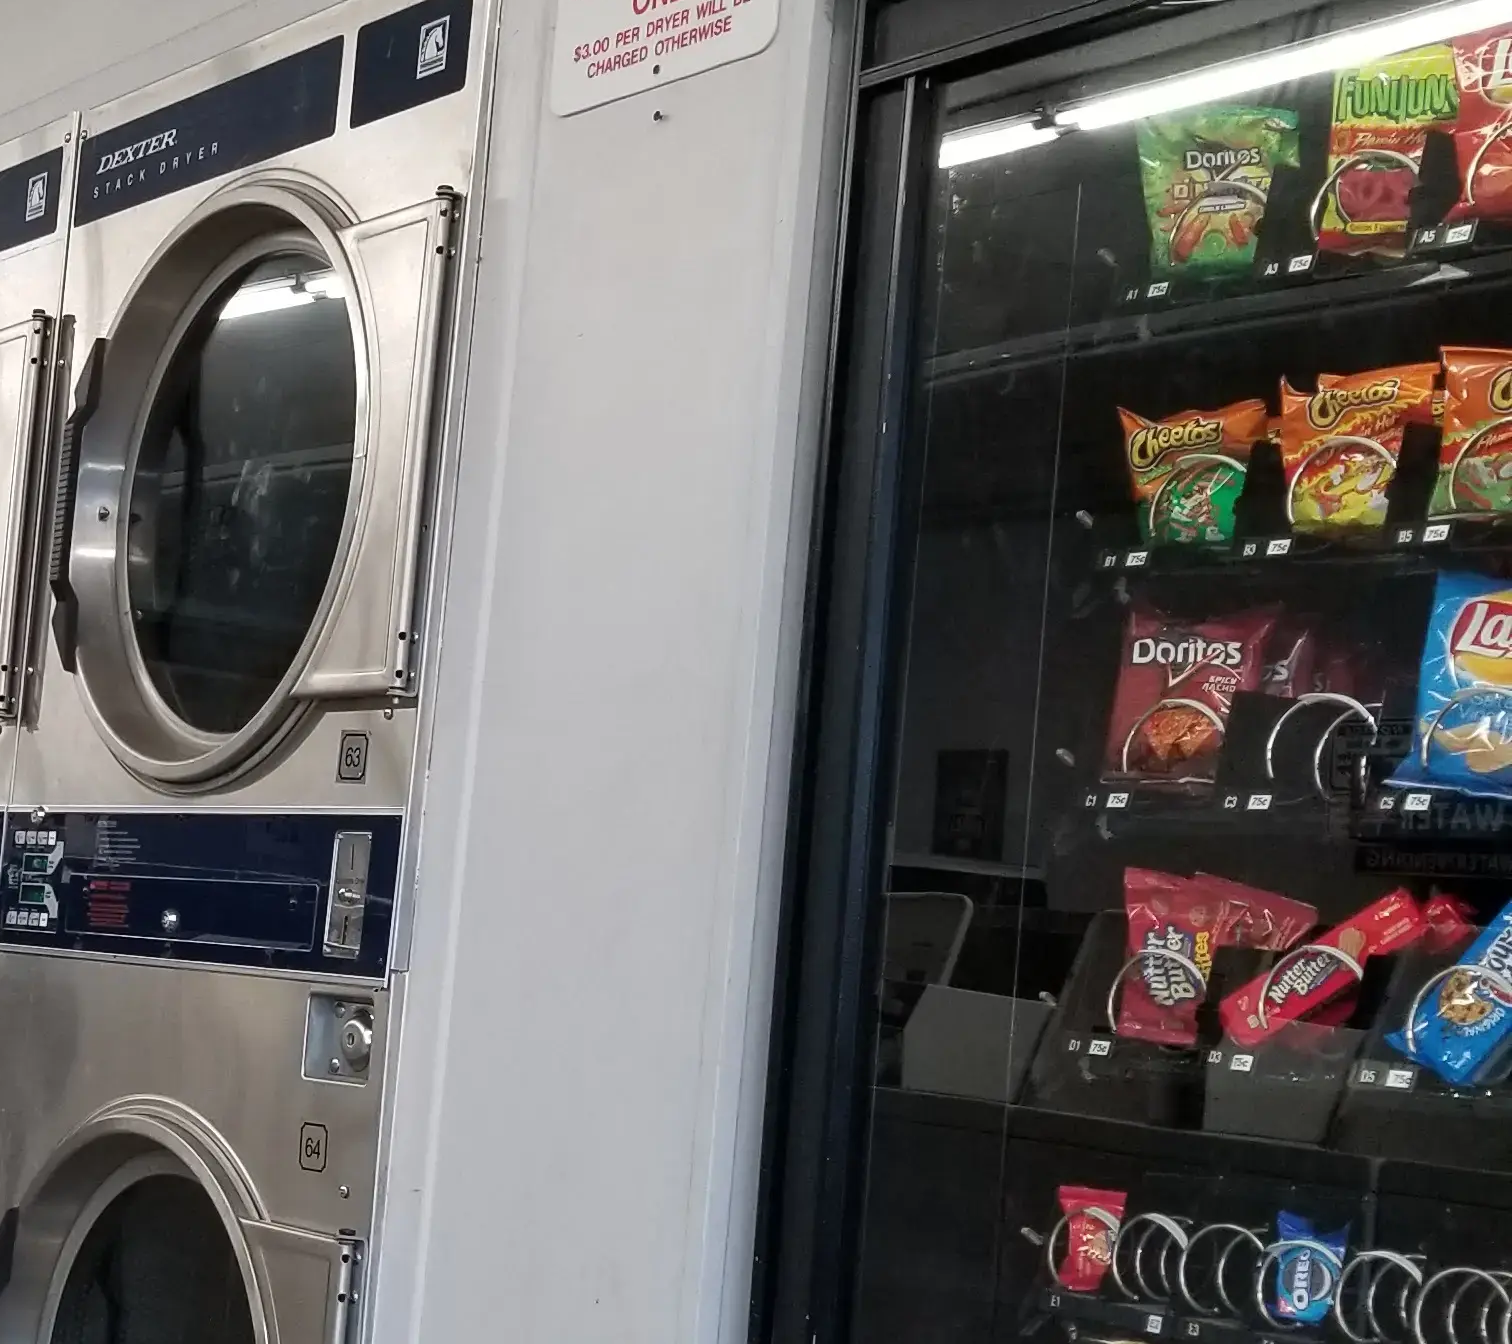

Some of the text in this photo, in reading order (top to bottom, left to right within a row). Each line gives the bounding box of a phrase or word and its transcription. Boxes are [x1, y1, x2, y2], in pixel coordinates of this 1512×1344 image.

[573, 36, 610, 63] $3.00
[615, 26, 640, 49] PER
[646, 9, 690, 38] DRYER
[586, 15, 733, 79] CHARGED OTHERWISE
[92, 142, 220, 199] STACK DRYER
[96, 128, 178, 175] DEXTER
[1185, 148, 1260, 170] Doritos
[1419, 229, 1436, 243] A5
[1310, 379, 1400, 429] Cheetos
[1130, 418, 1222, 469] Cheetos
[1132, 638, 1242, 665] Doritos
[1202, 683, 1237, 693] NACHO
[1208, 675, 1238, 684] SPICY
[344, 747, 361, 767] 63
[1143, 931, 1175, 1006] Nutter
[1165, 925, 1196, 999] Buter
[1268, 956, 1307, 1004] Nutter
[1293, 951, 1333, 996] Butter
[304, 1140, 322, 1159] 64
[1293, 1249, 1311, 1311] OREO
